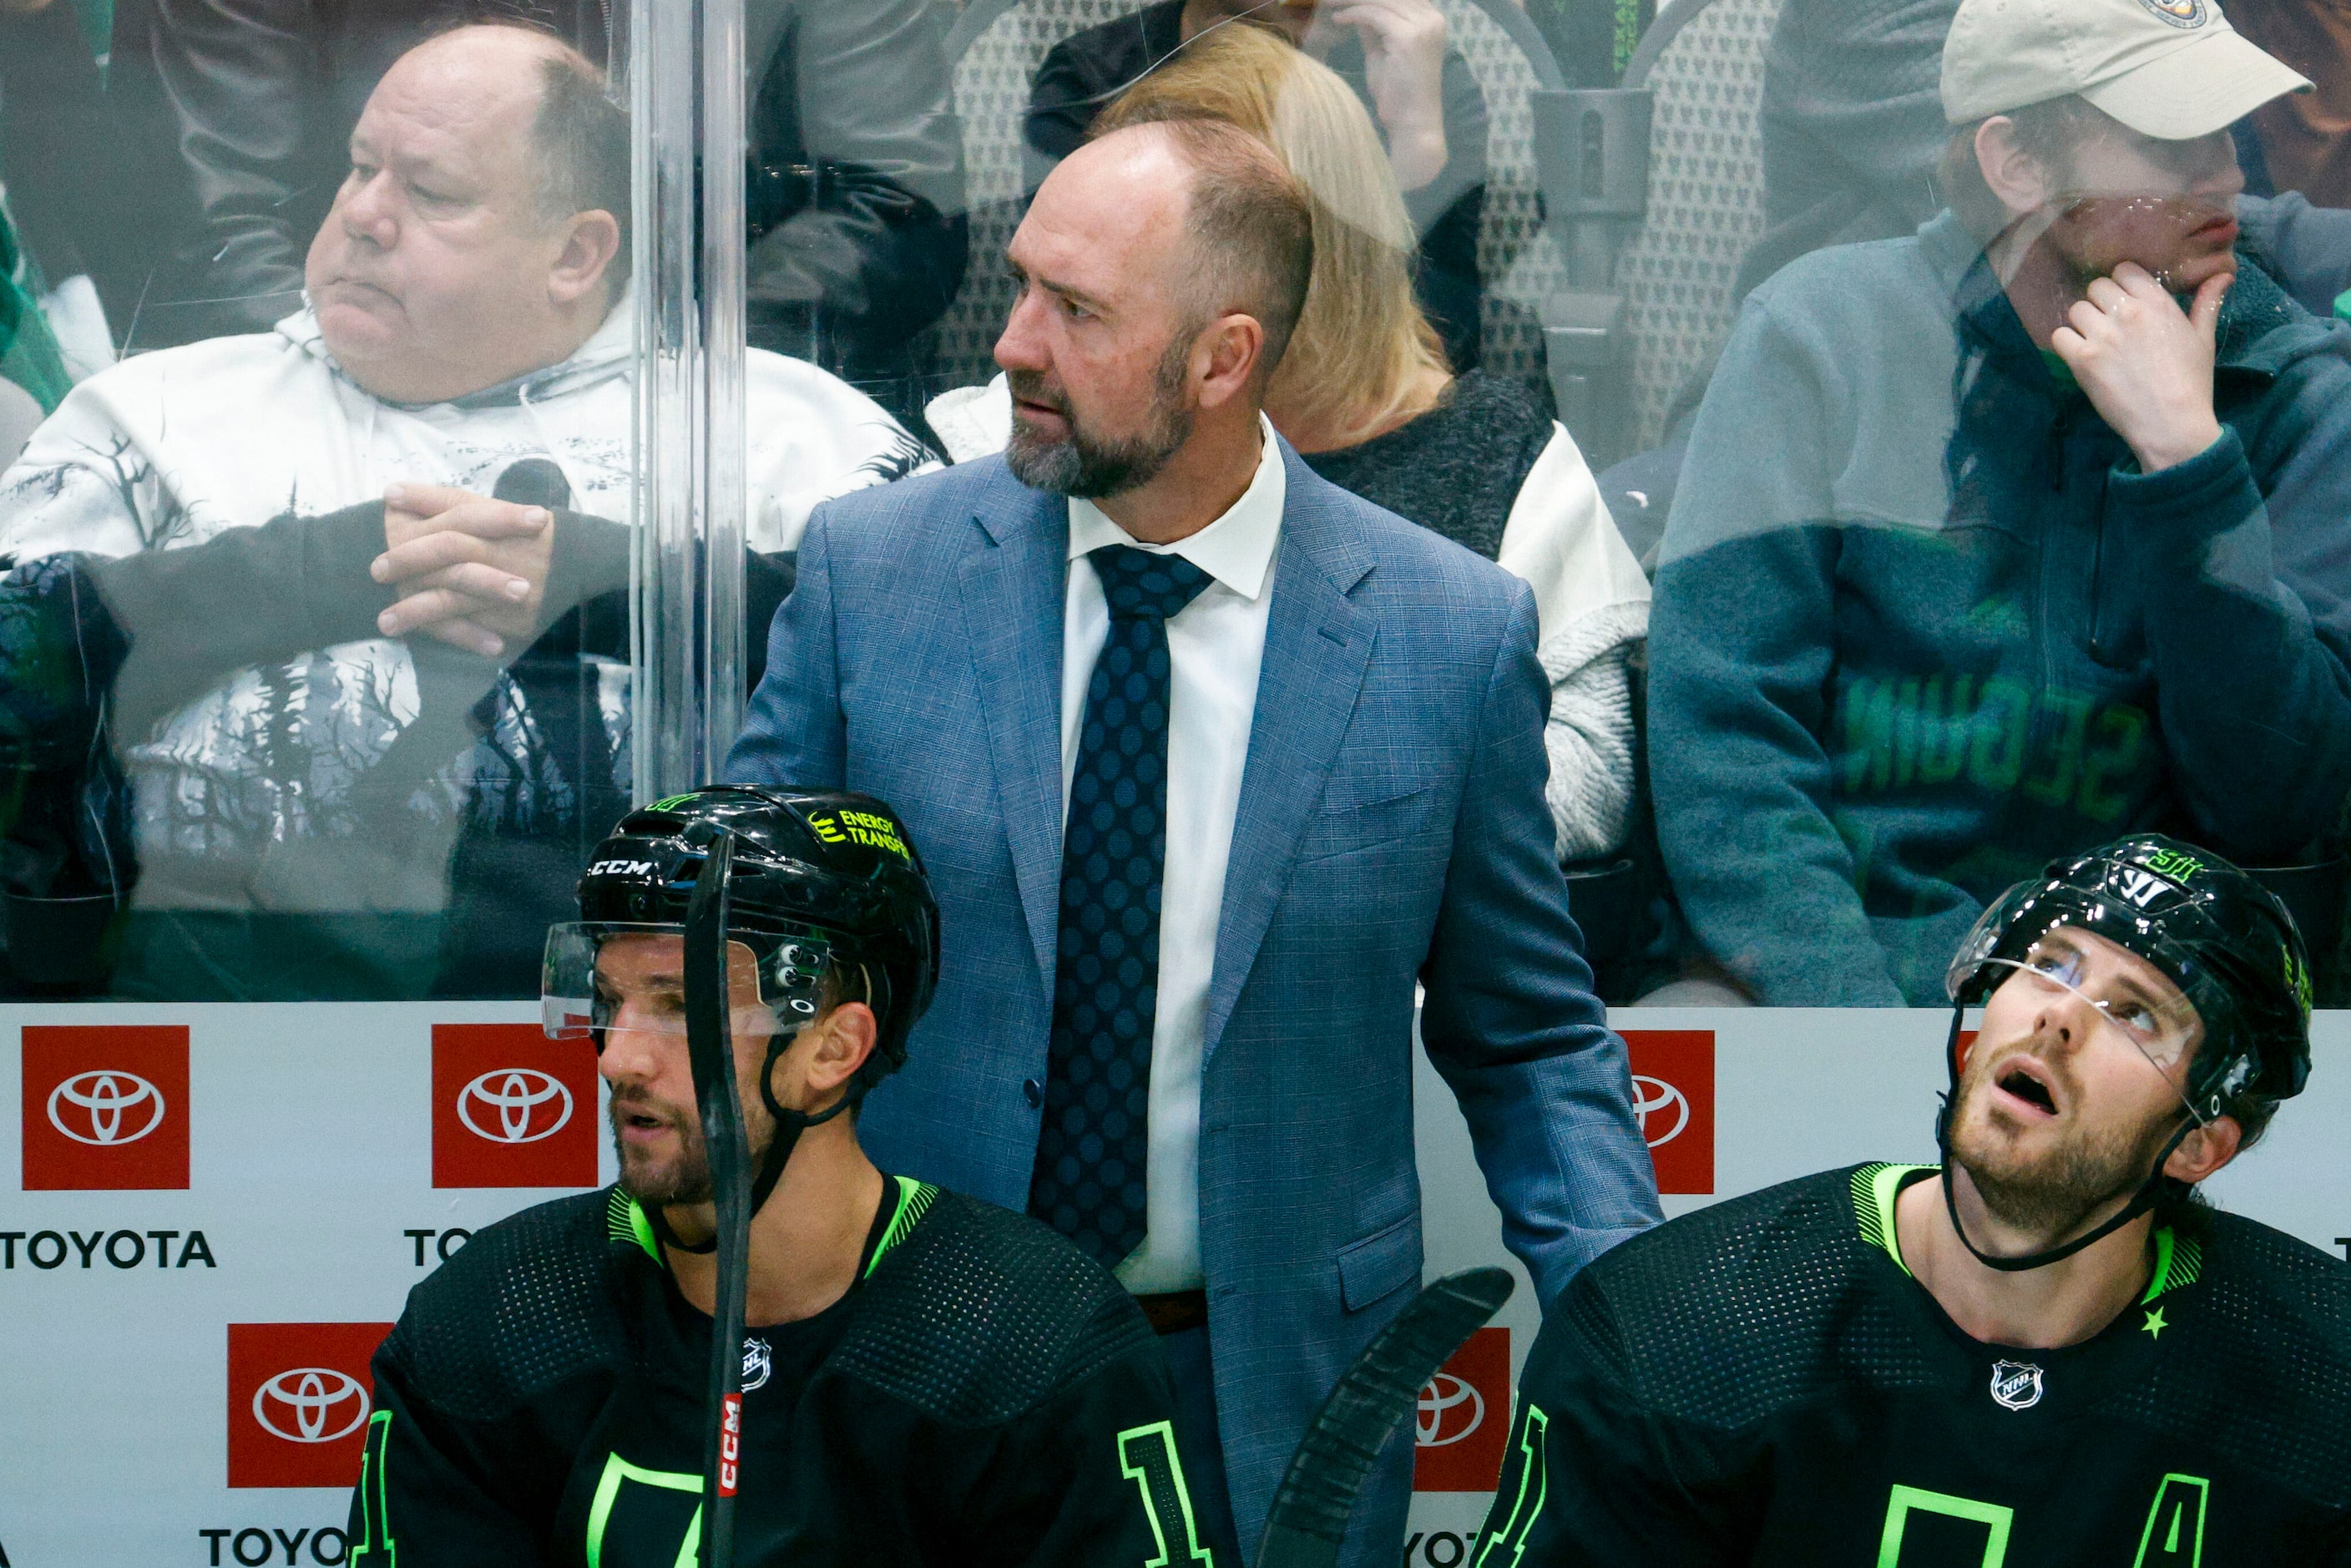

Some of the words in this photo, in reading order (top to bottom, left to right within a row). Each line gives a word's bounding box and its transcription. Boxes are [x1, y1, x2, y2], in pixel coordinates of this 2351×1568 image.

[838, 810, 894, 836] ENERGY
[590, 860, 653, 876] CCM
[0, 1230, 216, 1269] TOYOTA
[2002, 1373, 2033, 1396] NHL
[721, 1400, 741, 1490] CCM
[200, 1527, 348, 1567] TOYO
